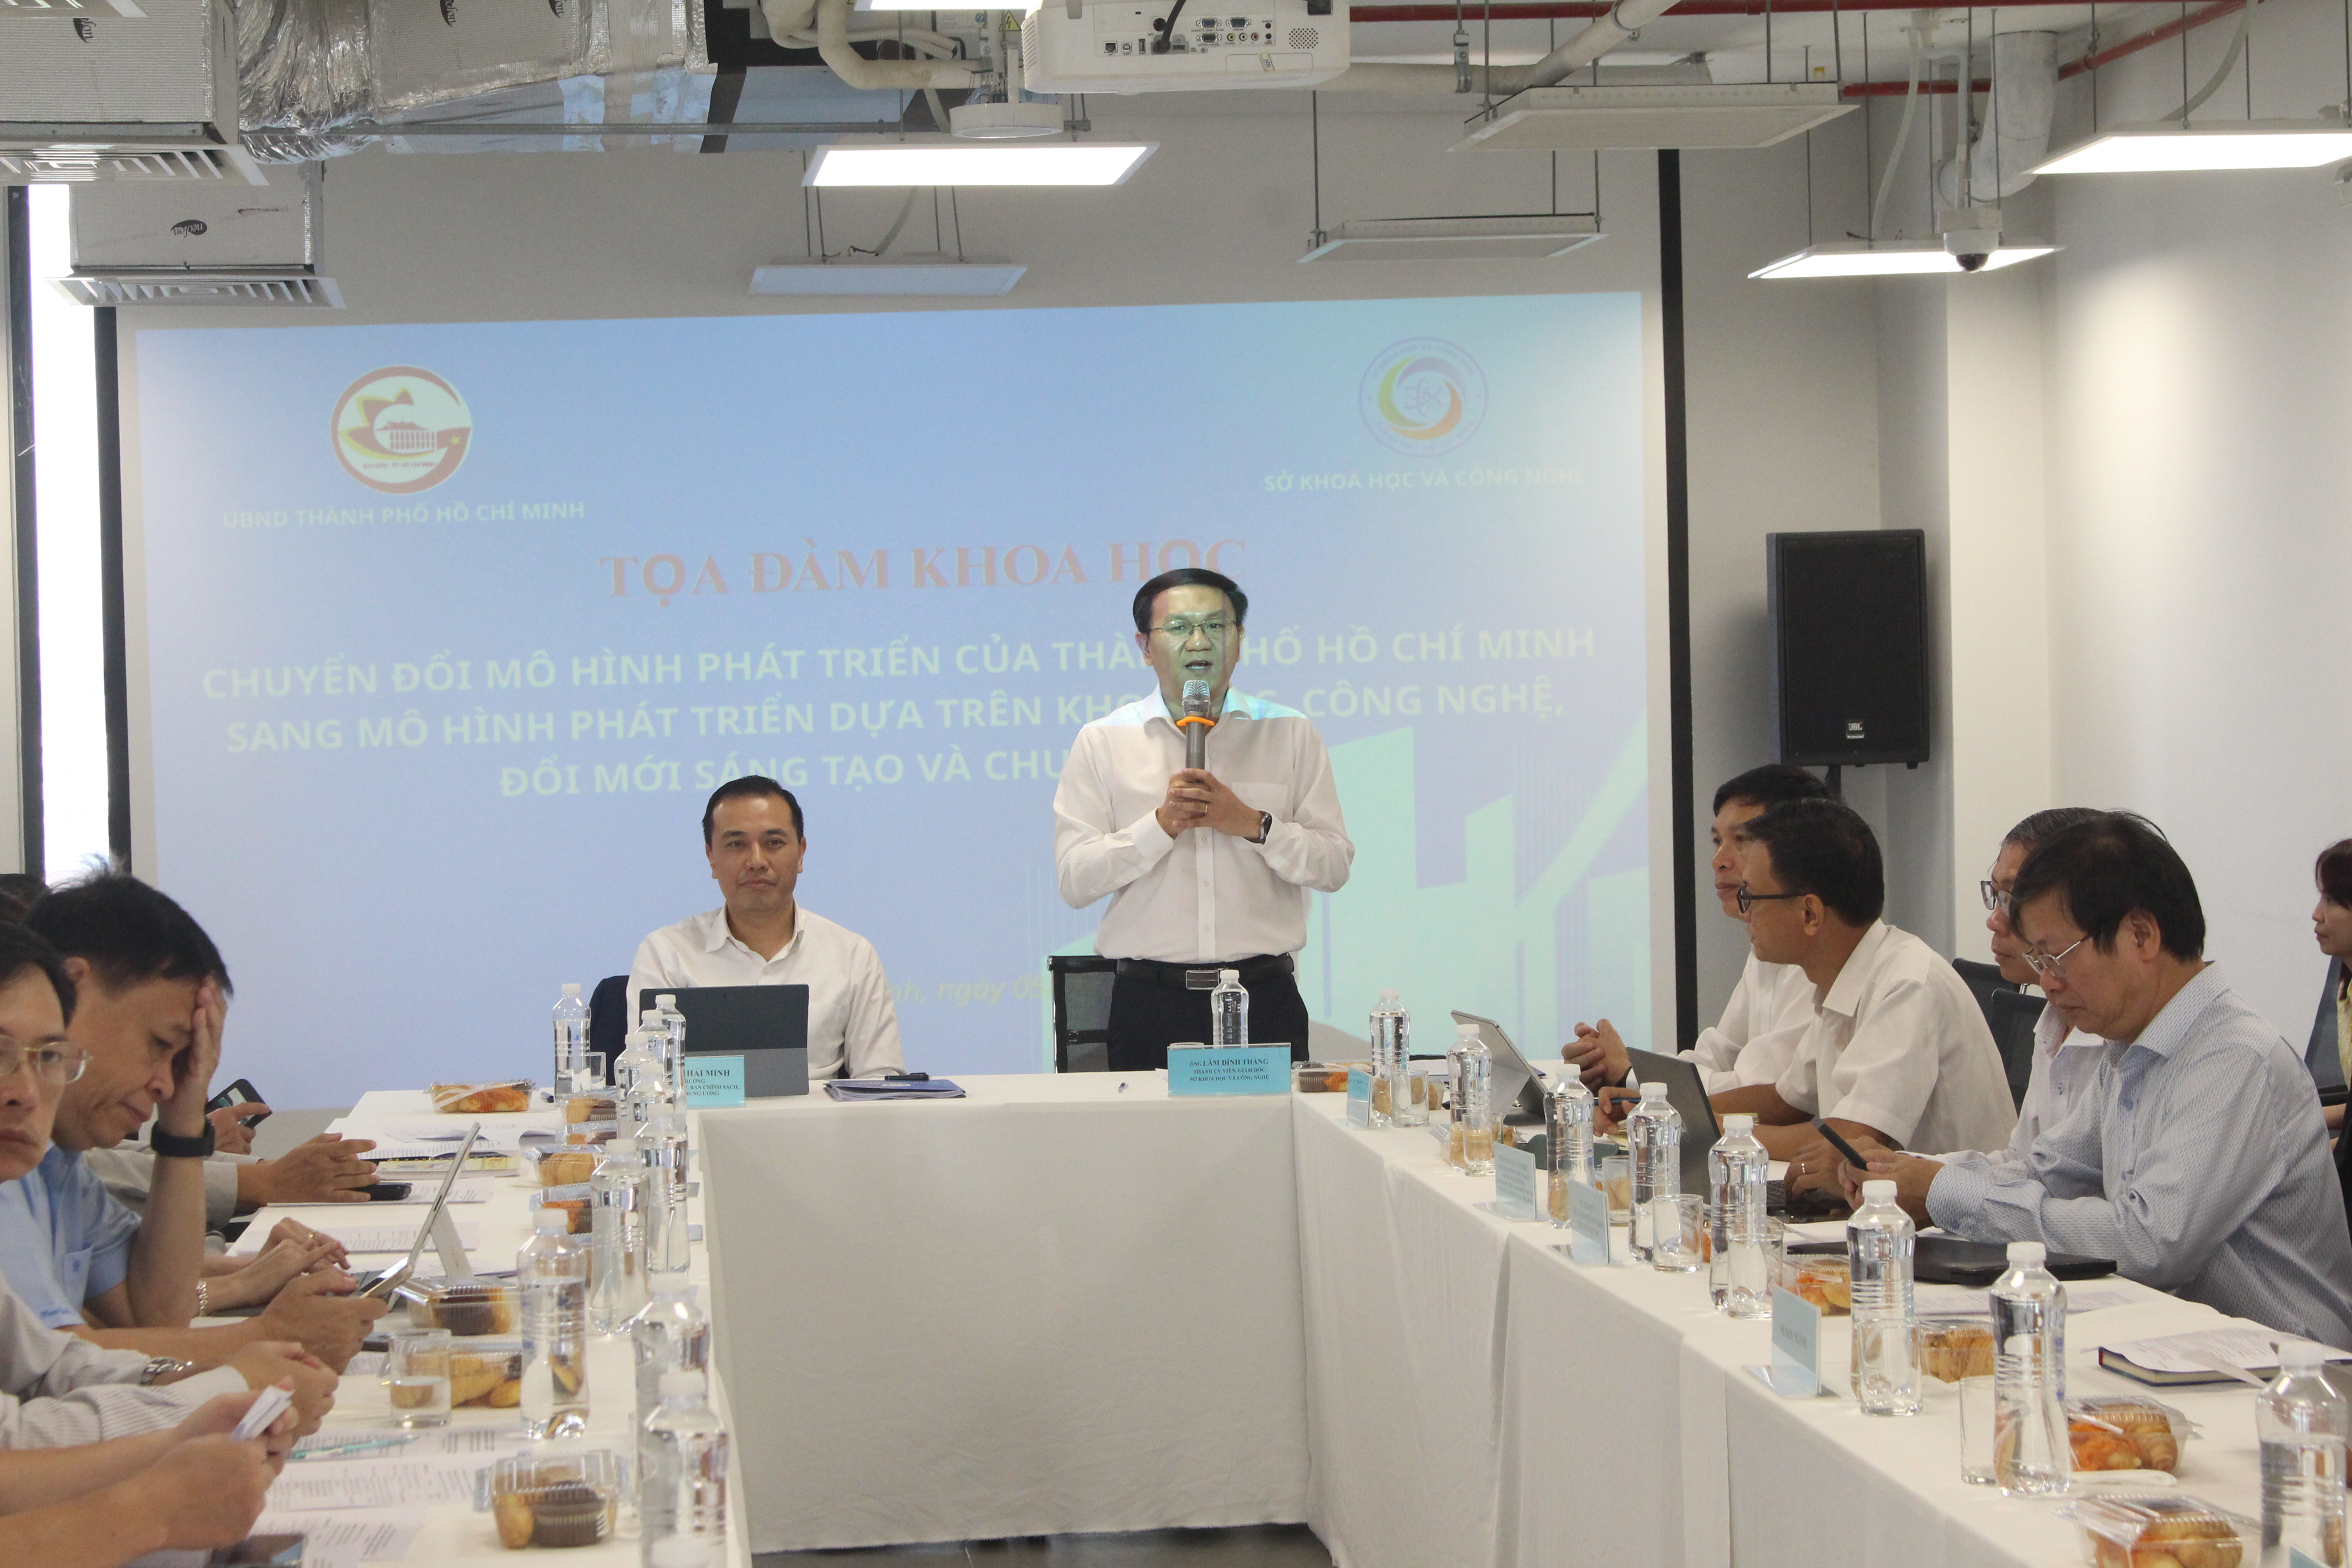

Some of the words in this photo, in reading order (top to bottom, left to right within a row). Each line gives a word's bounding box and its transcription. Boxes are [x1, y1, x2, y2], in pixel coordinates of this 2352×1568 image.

[1264, 469, 1294, 491] SỞ
[1300, 473, 1362, 490] KHOA
[1369, 472, 1415, 493] HỌC
[1420, 467, 1449, 487] VÀ
[1455, 466, 1518, 485] CÔNG
[1525, 464, 1586, 485] NGHỆ
[223, 511, 287, 529] UBND
[295, 504, 374, 526] THÀNH
[382, 501, 429, 524] PHỐ
[437, 500, 470, 521] HỒ
[477, 500, 514, 521] CHÍ
[523, 502, 584, 519] MINH
[600, 552, 729, 607] TỌA
[750, 538, 889, 593] ĐÀM
[912, 543, 1087, 588] KHOA
[203, 652, 377, 699] CHUYỂN
[392, 649, 471, 692] ĐỔI
[488, 650, 556, 689] MÔ
[573, 649, 681, 686] HÌNH
[699, 643, 805, 682] PHÁT
[818, 635, 939, 678] TRIỂN
[956, 634, 1040, 674] CỦA
[1053, 633, 1146, 671] THÀ
[1242, 625, 1302, 666] HỐ
[1317, 625, 1383, 664] HỒ
[1392, 624, 1462, 662] CHÍ
[1479, 629, 1594, 660] MINH
[227, 720, 342, 753] SANG
[359, 708, 428, 748] MÔ
[445, 707, 554, 745] HÌNH
[571, 701, 678, 740] PHÁT
[691, 692, 813, 735] TRIỂN
[832, 699, 924, 738] DỰA
[936, 690, 1041, 728] TRÊN
[1303, 680, 1421, 718] CÔNG
[1437, 676, 1564, 719] NGHỆ,
[1847, 722, 1863, 731] JBL
[500, 753, 579, 797] ĐỔI
[595, 754, 681, 793] MỚI
[696, 750, 808, 790] SÁNG
[822, 753, 904, 791] TẠO
[917, 744, 972, 782] VÀ
[985, 749, 1070, 780] CHU
[891, 980, 925, 1004] nh,
[937, 978, 1005, 1007] ngày
[1014, 976, 1052, 999] 05
